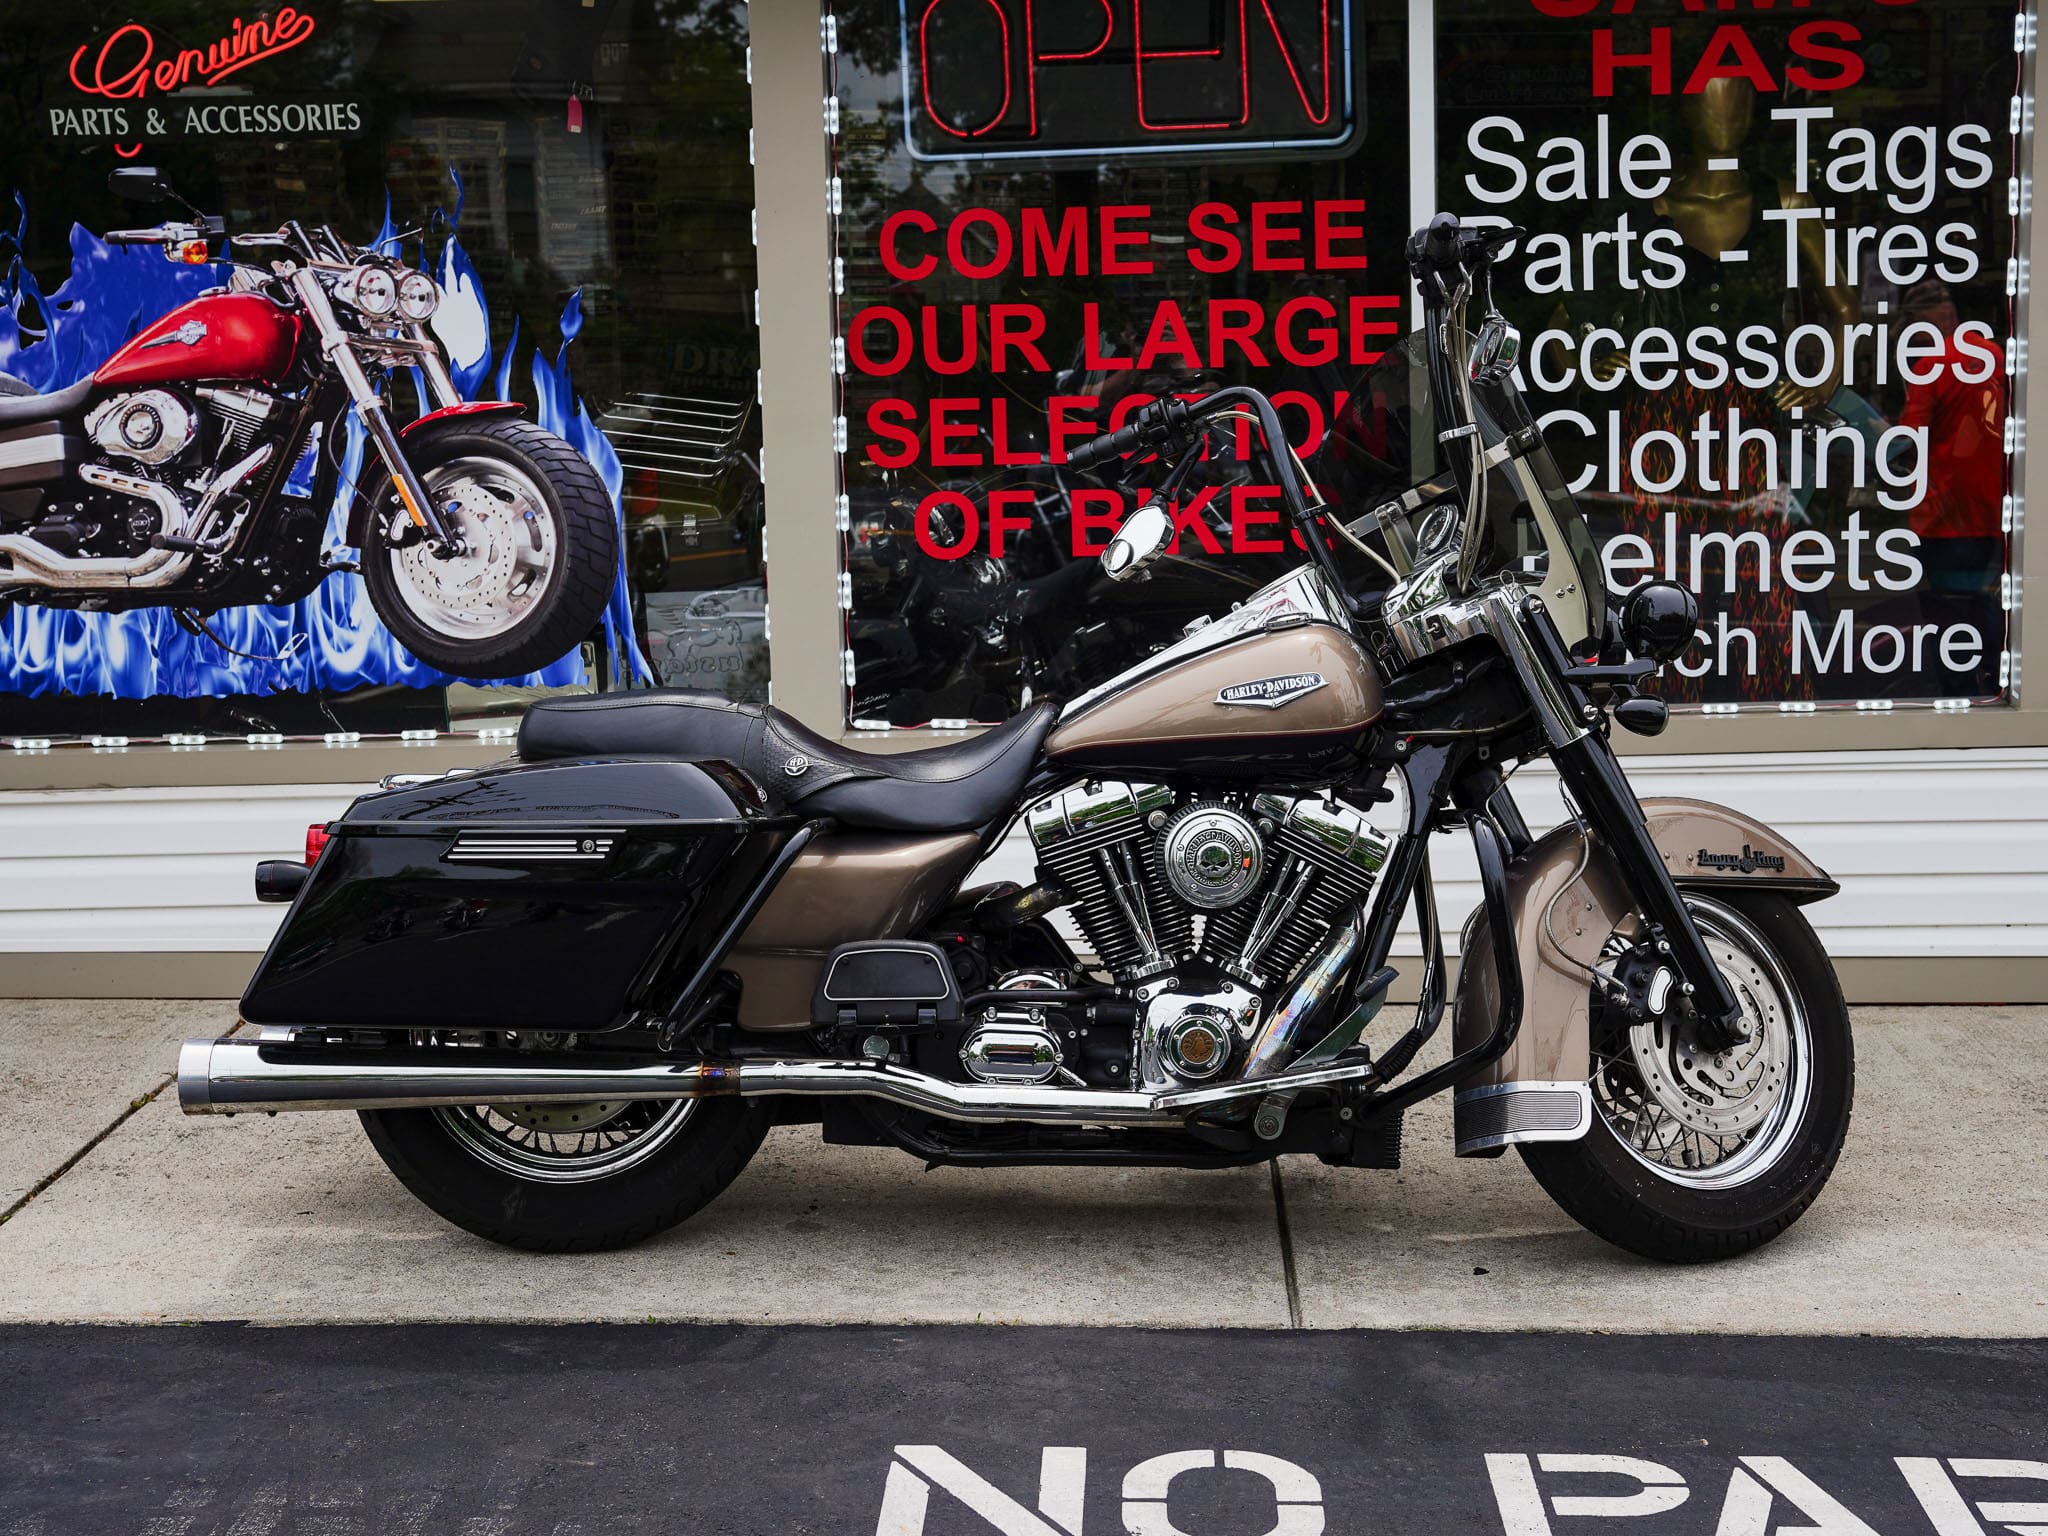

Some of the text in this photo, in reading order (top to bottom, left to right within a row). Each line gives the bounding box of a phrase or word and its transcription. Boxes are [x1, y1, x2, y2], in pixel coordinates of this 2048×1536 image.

[70, 7, 315, 98] Genuine
[920, 0, 1329, 137] OPEN
[1593, 22, 1863, 97] HAS
[49, 103, 361, 136] PARTS & ACCESSORIES
[1465, 114, 1672, 203] Sale
[1771, 106, 1993, 214] Tags
[879, 199, 1368, 281] COME SEE
[1763, 206, 1979, 288] Tires
[847, 295, 1401, 377] OUR LARGE
[1510, 302, 1996, 393] ccessories
[865, 390, 1387, 469] SELEION
[1537, 406, 1929, 511] Clothing
[913, 484, 1338, 561] OF BKE
[1523, 510, 1923, 595] elmets
[1640, 609, 1983, 678] ch More
[1225, 675, 1317, 699] HARLEY-DAVIDSON
[875, 1444, 1326, 1536] NO
